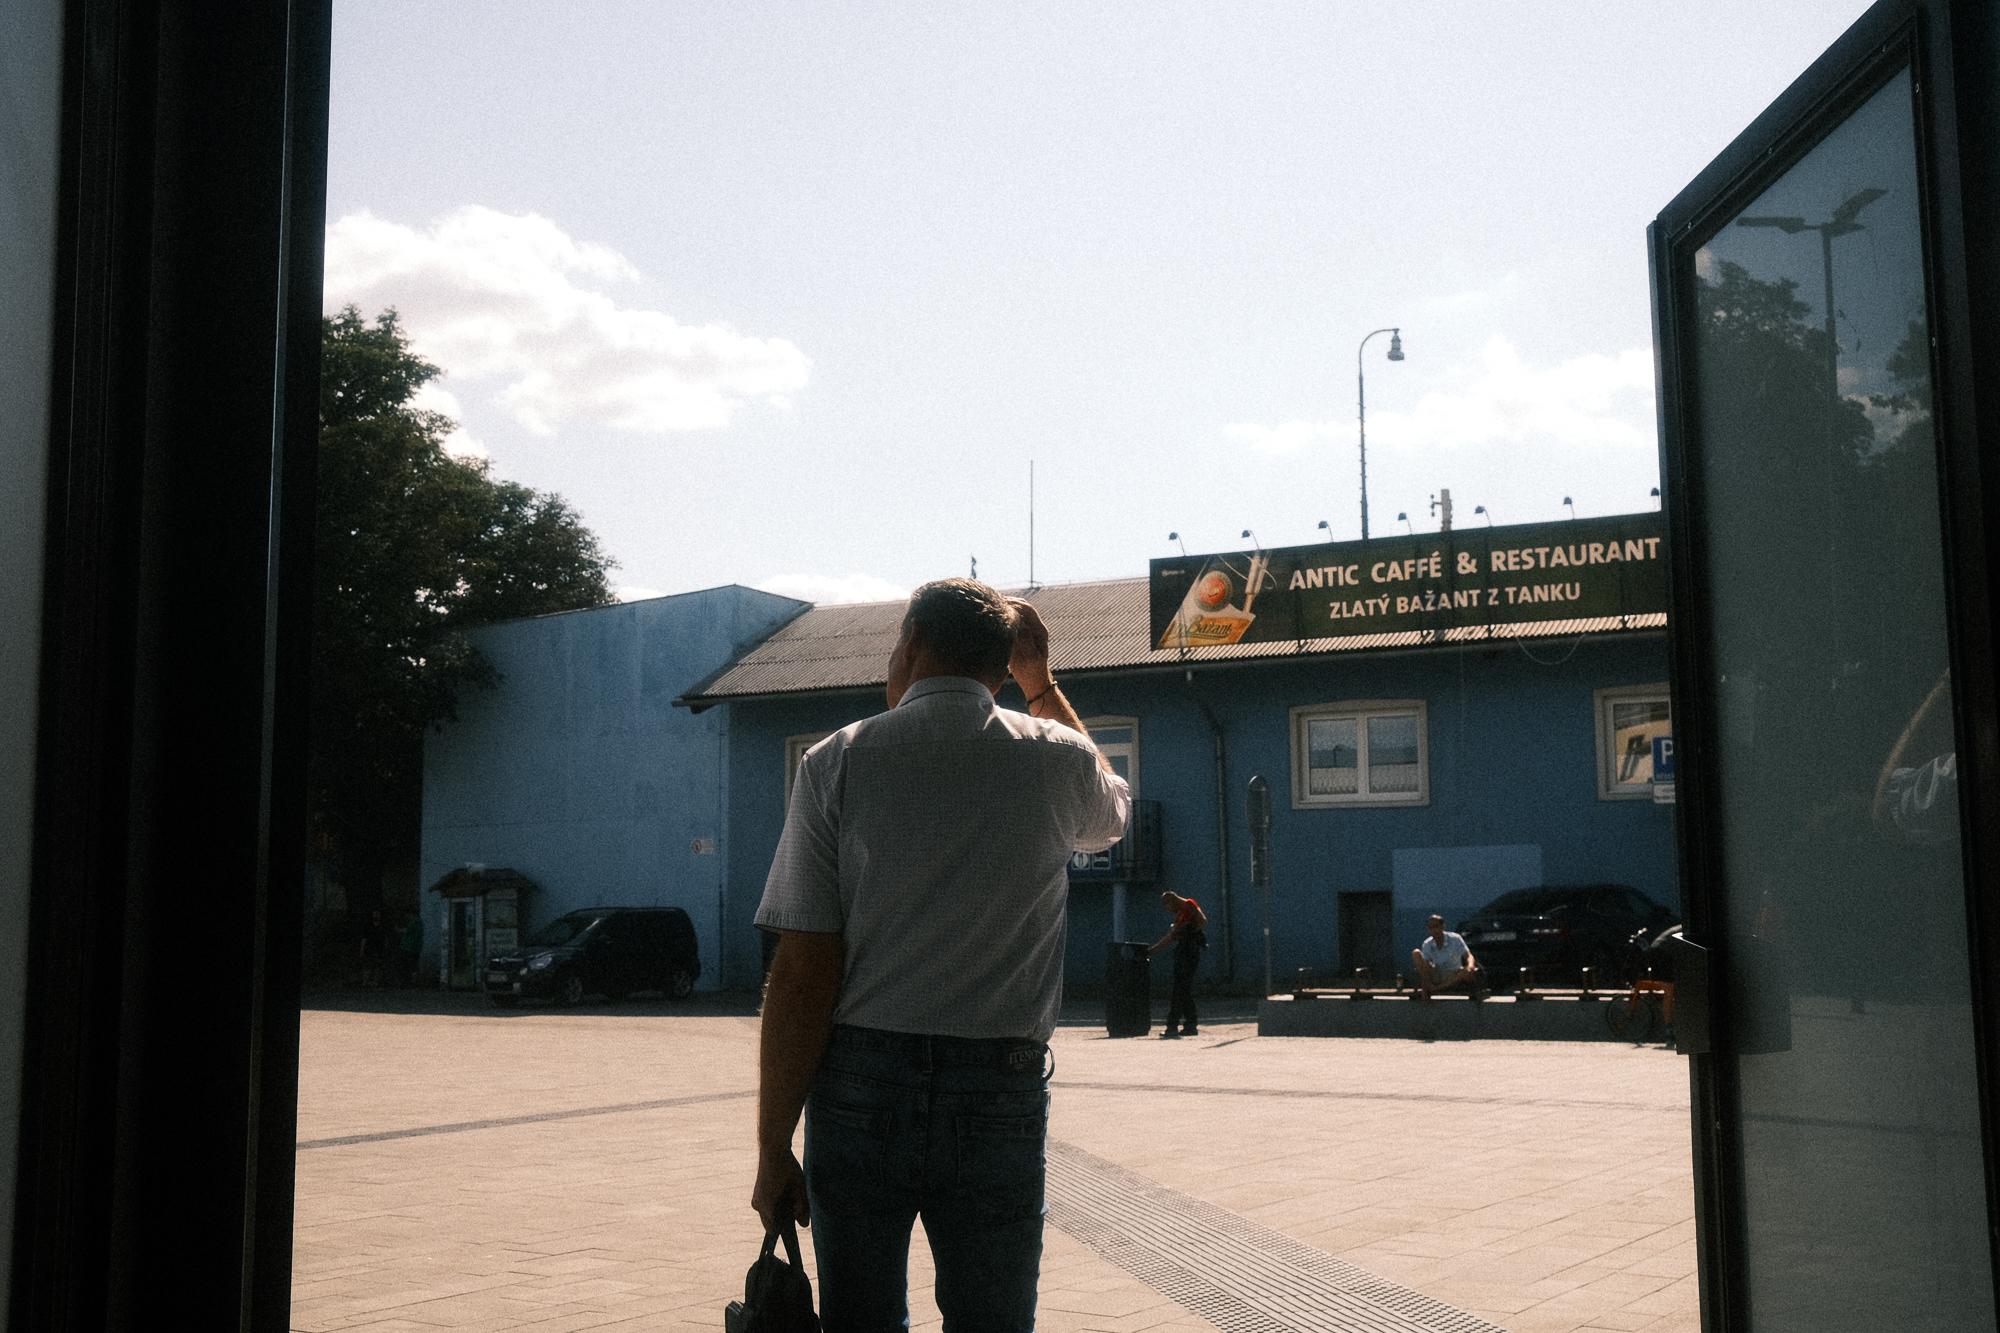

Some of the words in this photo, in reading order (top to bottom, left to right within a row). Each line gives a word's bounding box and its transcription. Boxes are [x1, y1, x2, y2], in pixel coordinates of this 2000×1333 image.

[1289, 564, 1360, 591] ANTIC
[1371, 550, 1442, 584] CAFFÉ
[1456, 551, 1478, 575] &
[1490, 537, 1661, 572] RESTAURANT
[1329, 593, 1391, 619] ZLATÝ
[1396, 589, 1481, 614] BAŽANT
[1487, 587, 1500, 606] Z
[1505, 582, 1581, 604] TANKU
[1661, 738, 1674, 765] P
